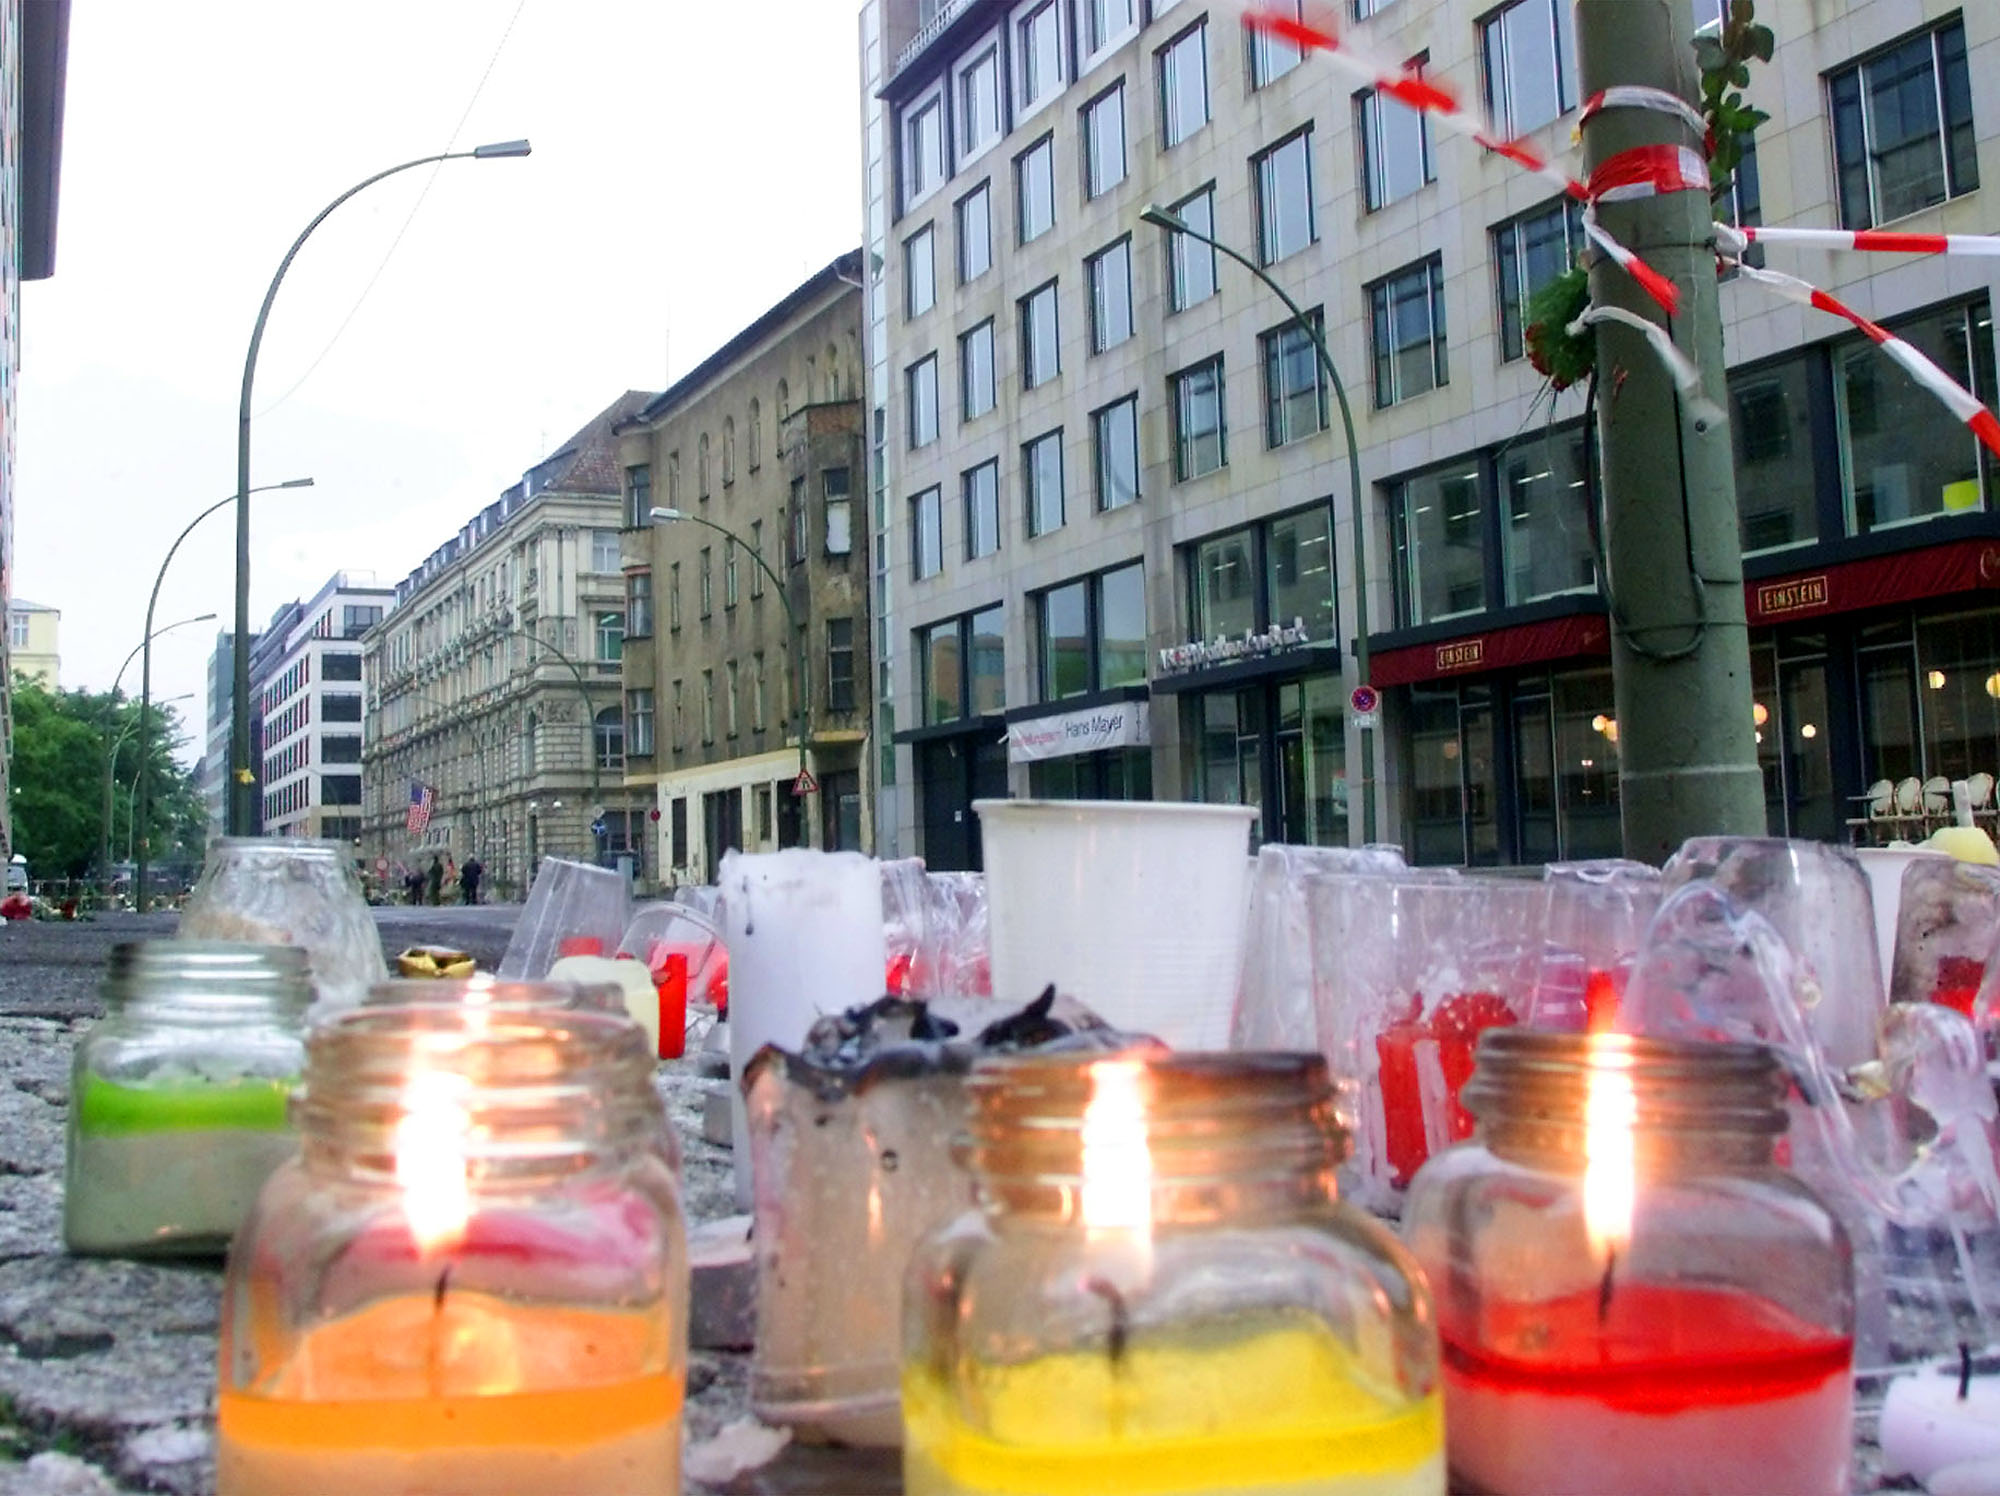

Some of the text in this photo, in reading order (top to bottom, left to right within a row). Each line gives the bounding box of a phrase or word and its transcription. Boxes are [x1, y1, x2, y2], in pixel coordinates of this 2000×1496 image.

[1764, 583, 1822, 609] EINSTEIN
[1065, 714, 1124, 738] Hans Mayer
